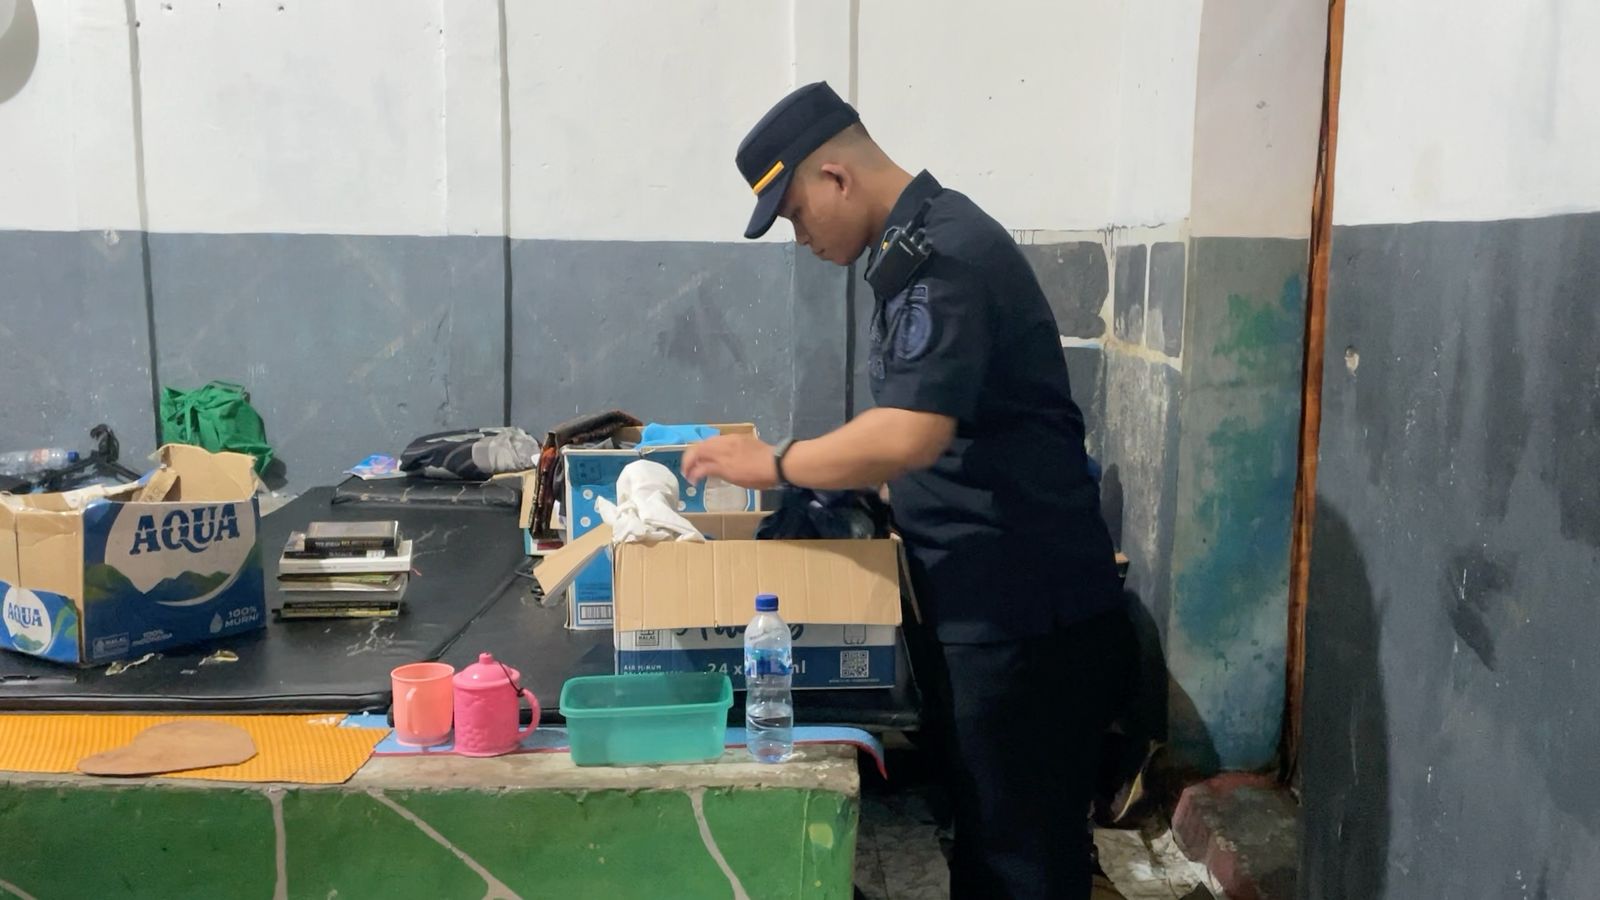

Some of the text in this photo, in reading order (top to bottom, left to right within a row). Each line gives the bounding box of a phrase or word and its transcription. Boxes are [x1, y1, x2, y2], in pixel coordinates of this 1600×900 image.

[129, 503, 240, 555] AQUA
[8, 602, 43, 628] AQUA
[225, 612, 259, 628] MURNI
[229, 606, 257, 618] 100%
[707, 663, 728, 673] 24
